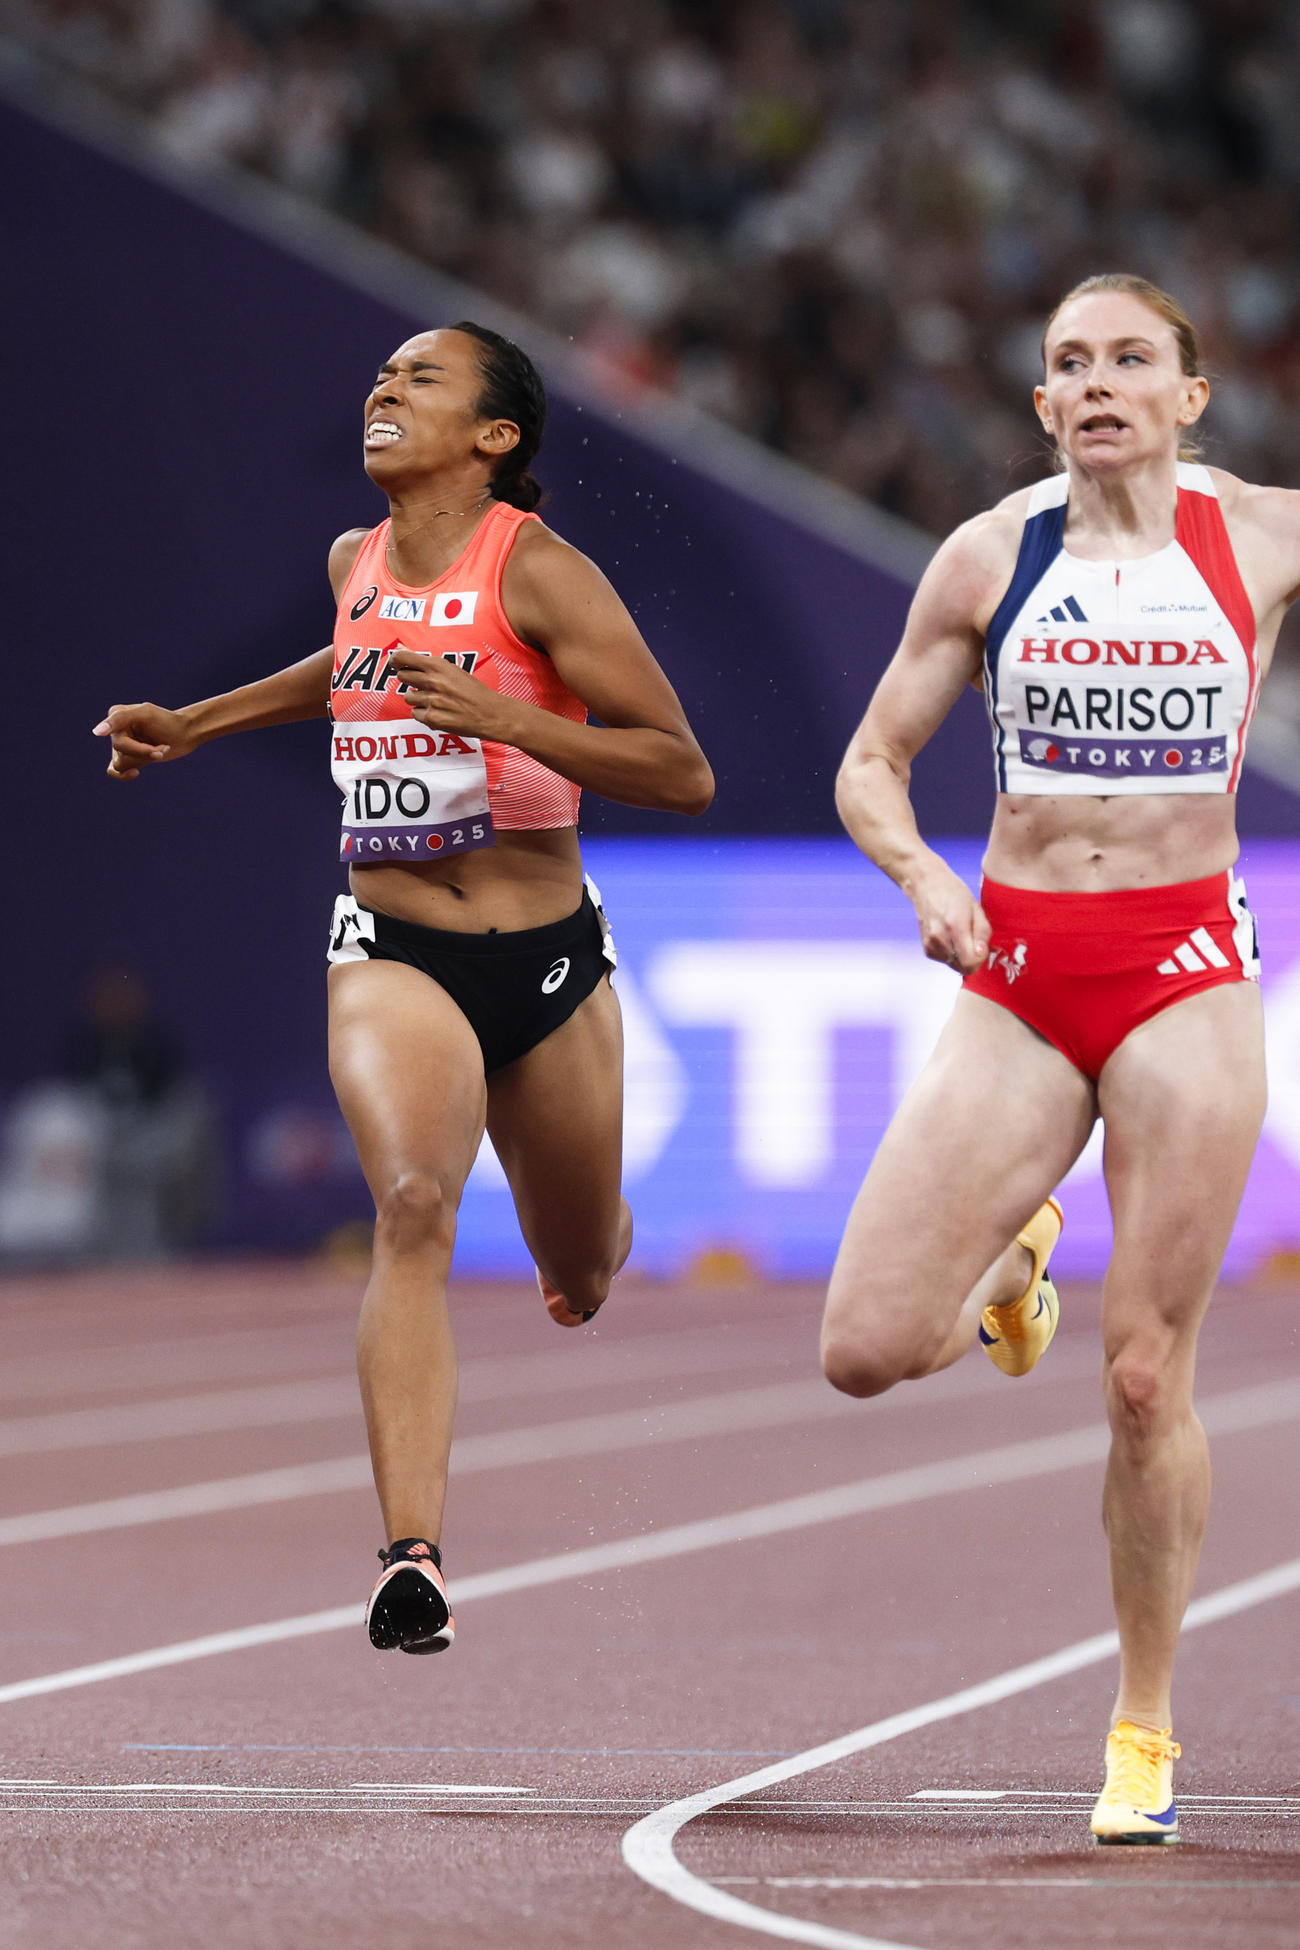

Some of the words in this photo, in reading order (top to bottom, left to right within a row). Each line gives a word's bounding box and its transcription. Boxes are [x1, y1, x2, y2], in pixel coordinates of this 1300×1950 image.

[381, 599, 424, 619] ACN
[1017, 638, 1228, 666] HONDA
[331, 648, 477, 694] JAP
[1025, 685, 1222, 731] PARISOT
[334, 733, 477, 762] HONDA
[1190, 747, 1225, 766] 25
[354, 777, 431, 820] IDO
[452, 824, 485, 845] 25
